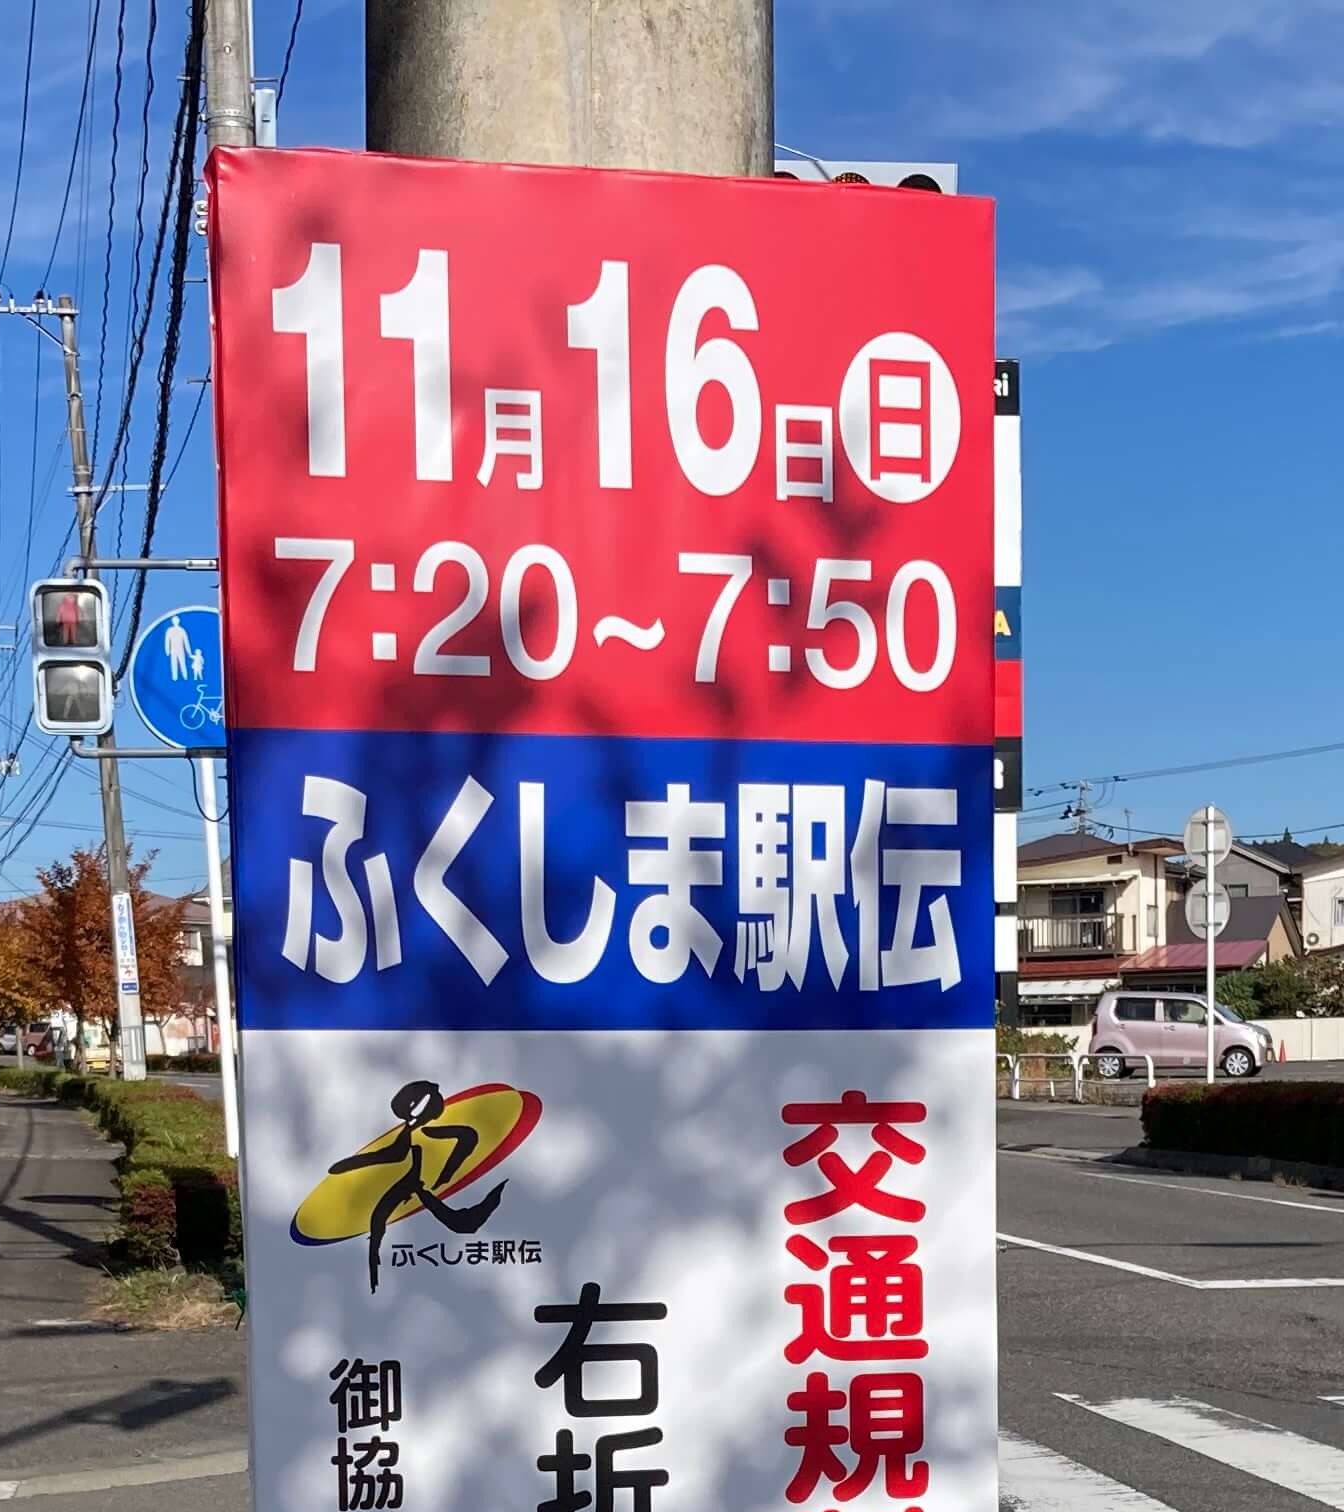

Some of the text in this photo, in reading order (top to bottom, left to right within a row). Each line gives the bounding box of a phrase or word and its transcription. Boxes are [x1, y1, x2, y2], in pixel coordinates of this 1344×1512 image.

[282, 775, 962, 994] ふくしま駅伝
[390, 1238, 542, 1269] ふくしま駅伝
